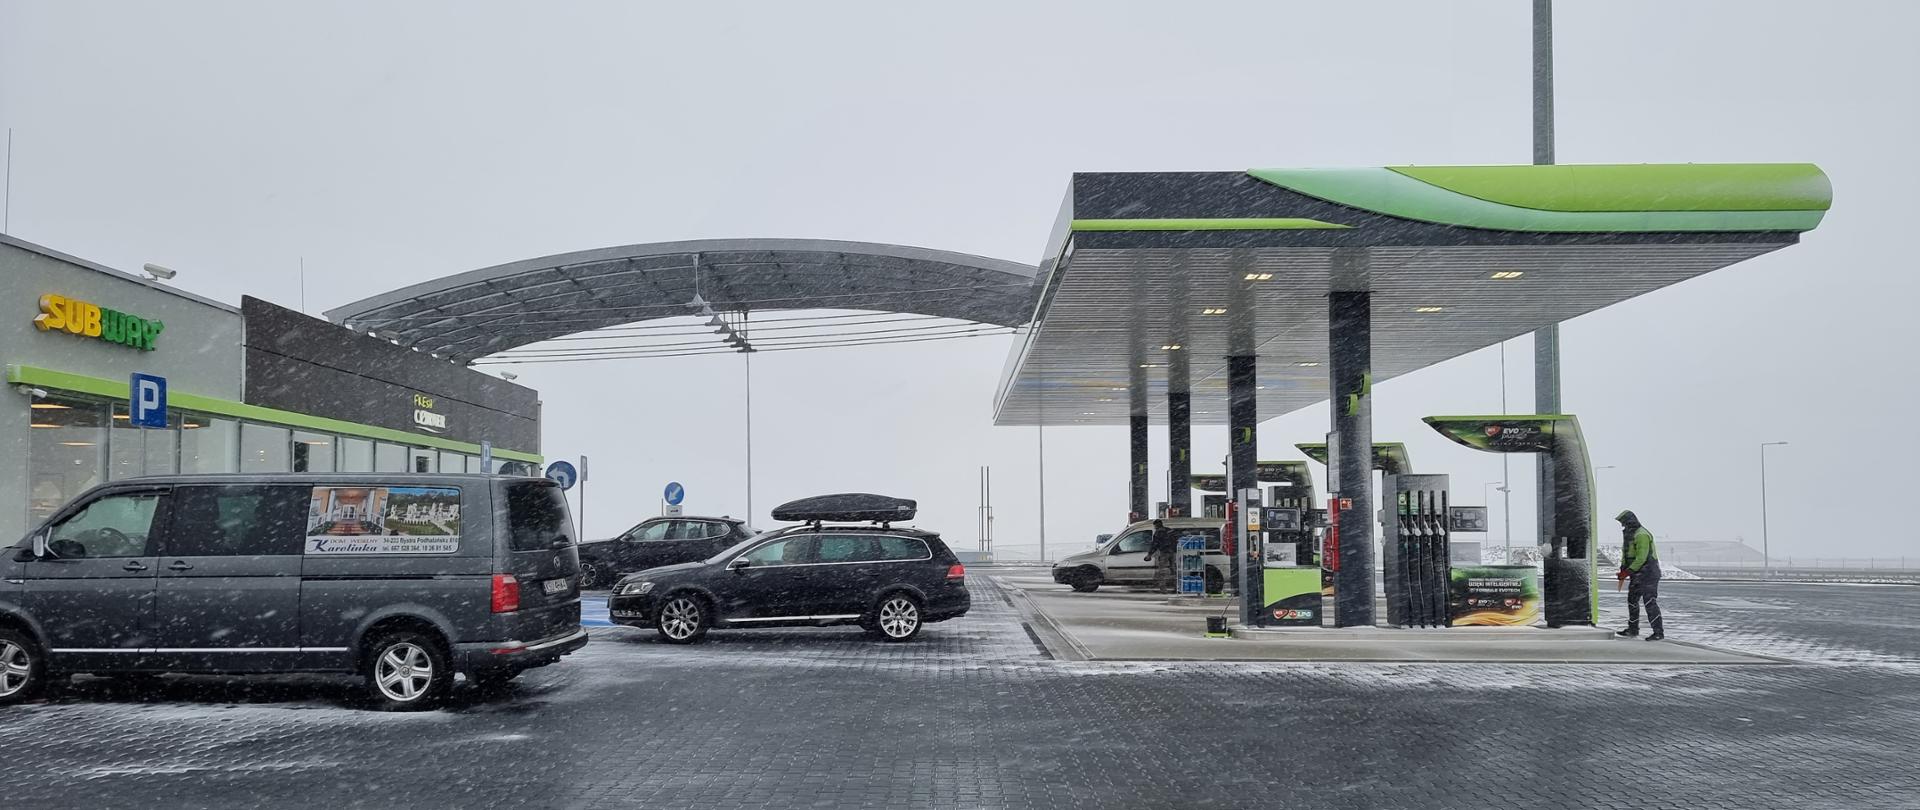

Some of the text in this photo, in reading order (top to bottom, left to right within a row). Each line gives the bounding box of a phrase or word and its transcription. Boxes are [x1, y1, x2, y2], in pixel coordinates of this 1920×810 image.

[33, 294, 164, 351] SUBWAY
[139, 379, 160, 421] P
[308, 539, 378, 553] Karolinka
